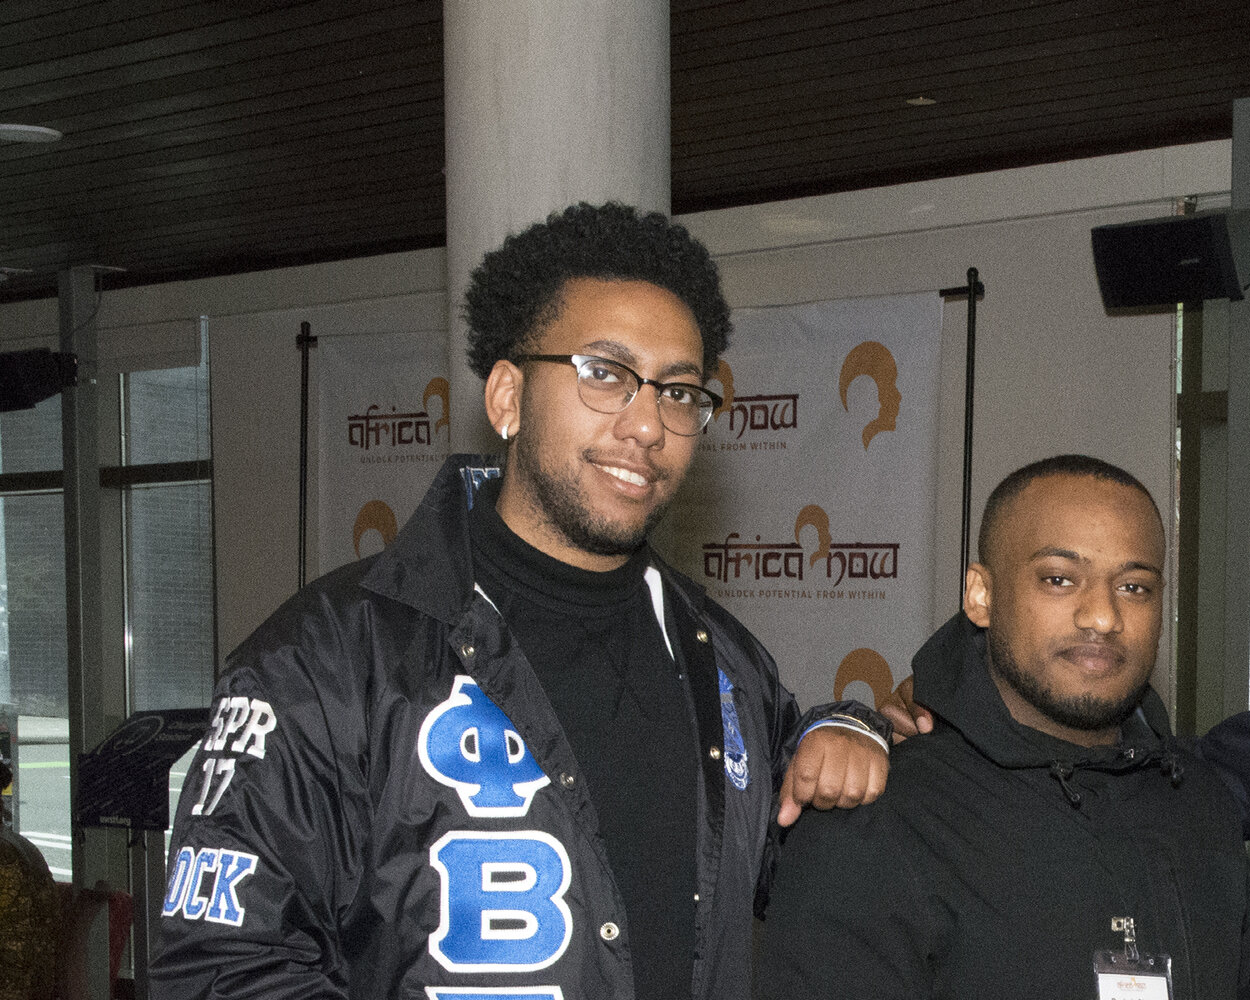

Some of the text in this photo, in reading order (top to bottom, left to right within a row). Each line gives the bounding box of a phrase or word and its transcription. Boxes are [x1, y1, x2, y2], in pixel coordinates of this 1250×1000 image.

[348, 404, 431, 450] africa
[730, 393, 799, 439] now
[721, 443, 747, 451] FROM
[750, 441, 787, 450] WITHIN
[702, 532, 900, 588] africa now
[717, 590, 886, 600] UNLOCK POTENTIAL FROM WITHIN
[191, 758, 236, 816] 17
